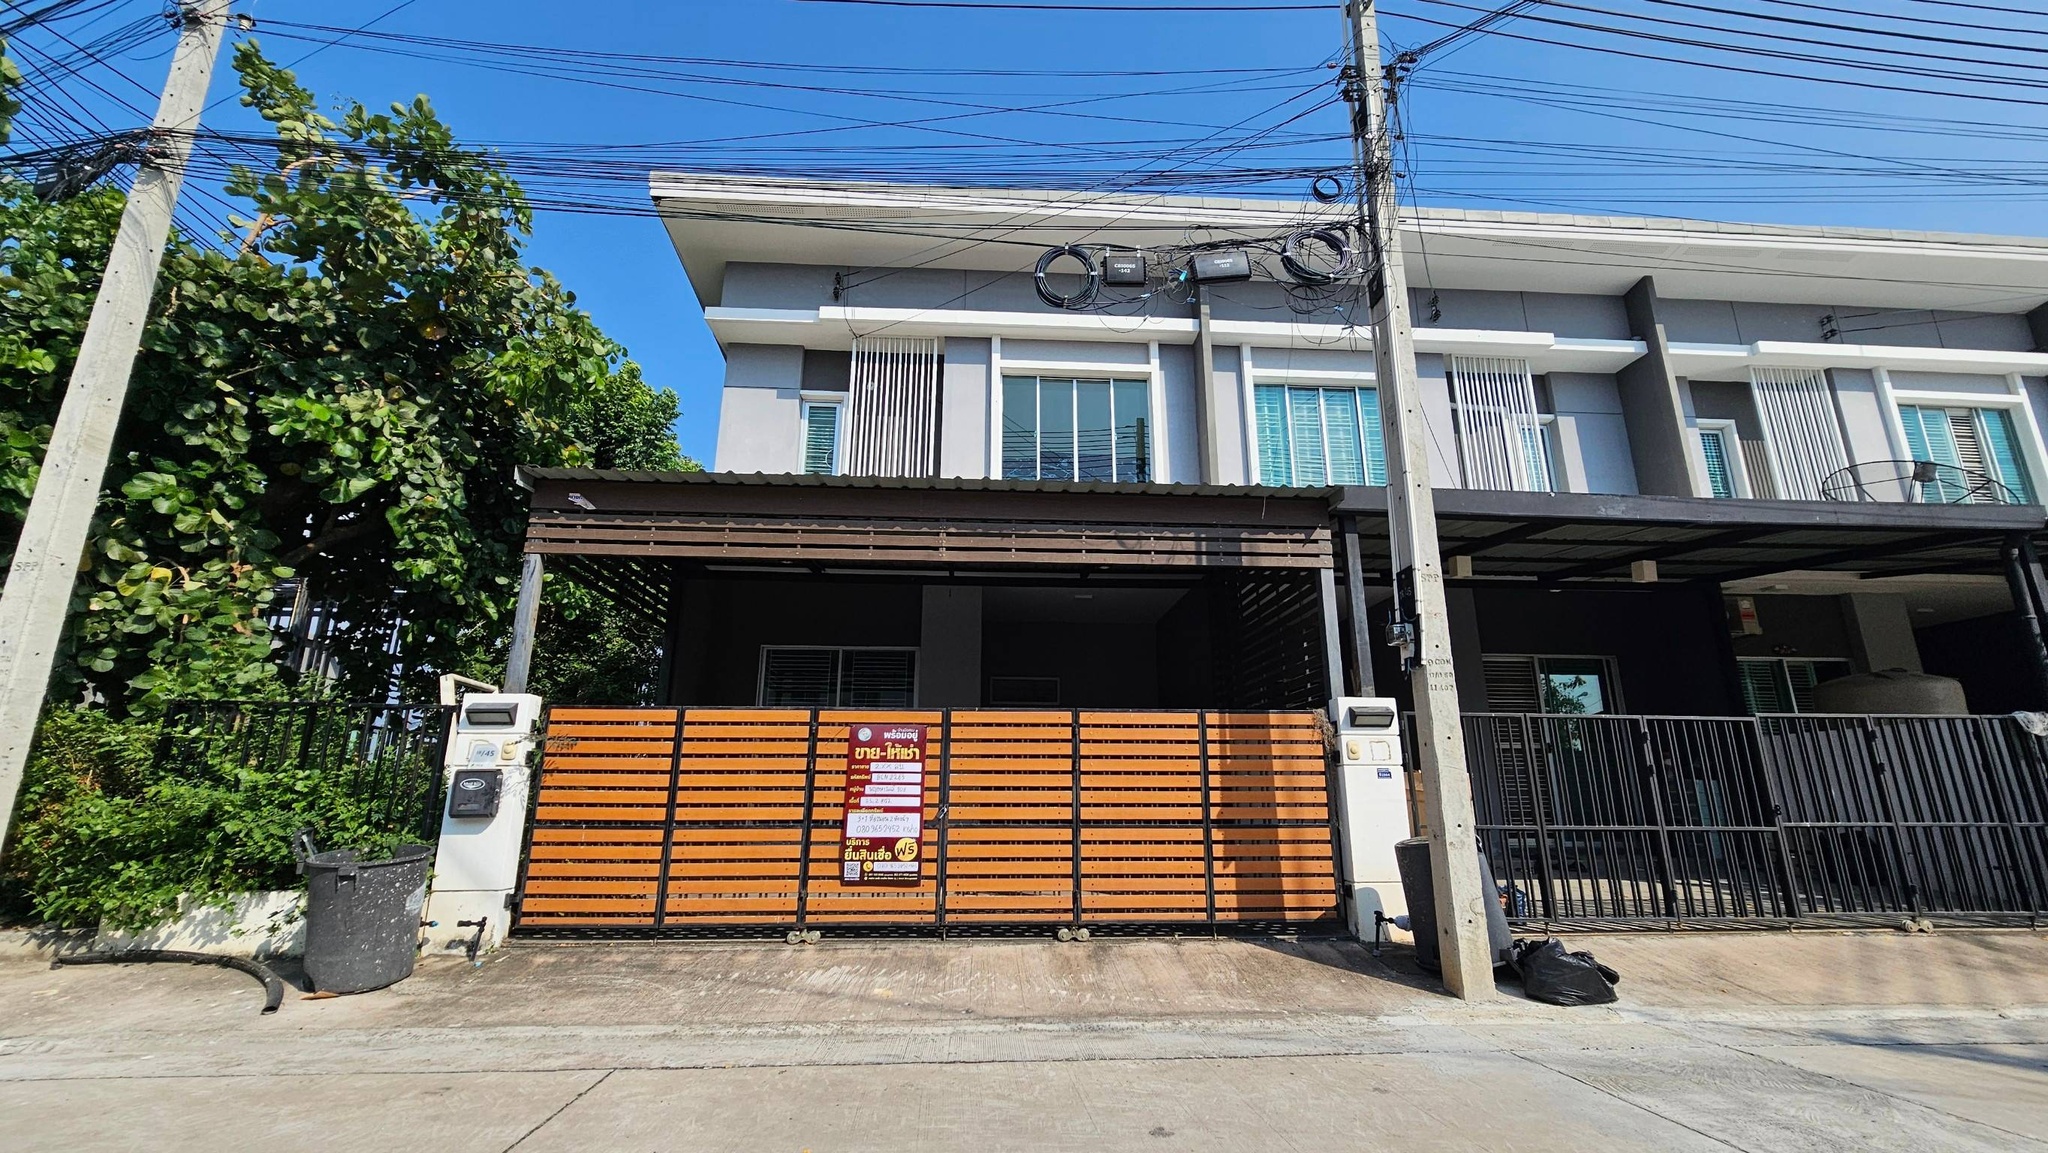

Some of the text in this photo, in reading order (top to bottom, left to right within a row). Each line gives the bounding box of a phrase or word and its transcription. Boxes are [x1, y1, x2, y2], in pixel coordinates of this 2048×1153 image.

[883, 729, 918, 742] พร้อมอยู่
[855, 742, 920, 760] ขาย-ให้เช่า
[845, 838, 870, 846] บริการ
[896, 841, 915, 857] ฟรี
[844, 845, 892, 860] ยื่นสินเชื่อ
